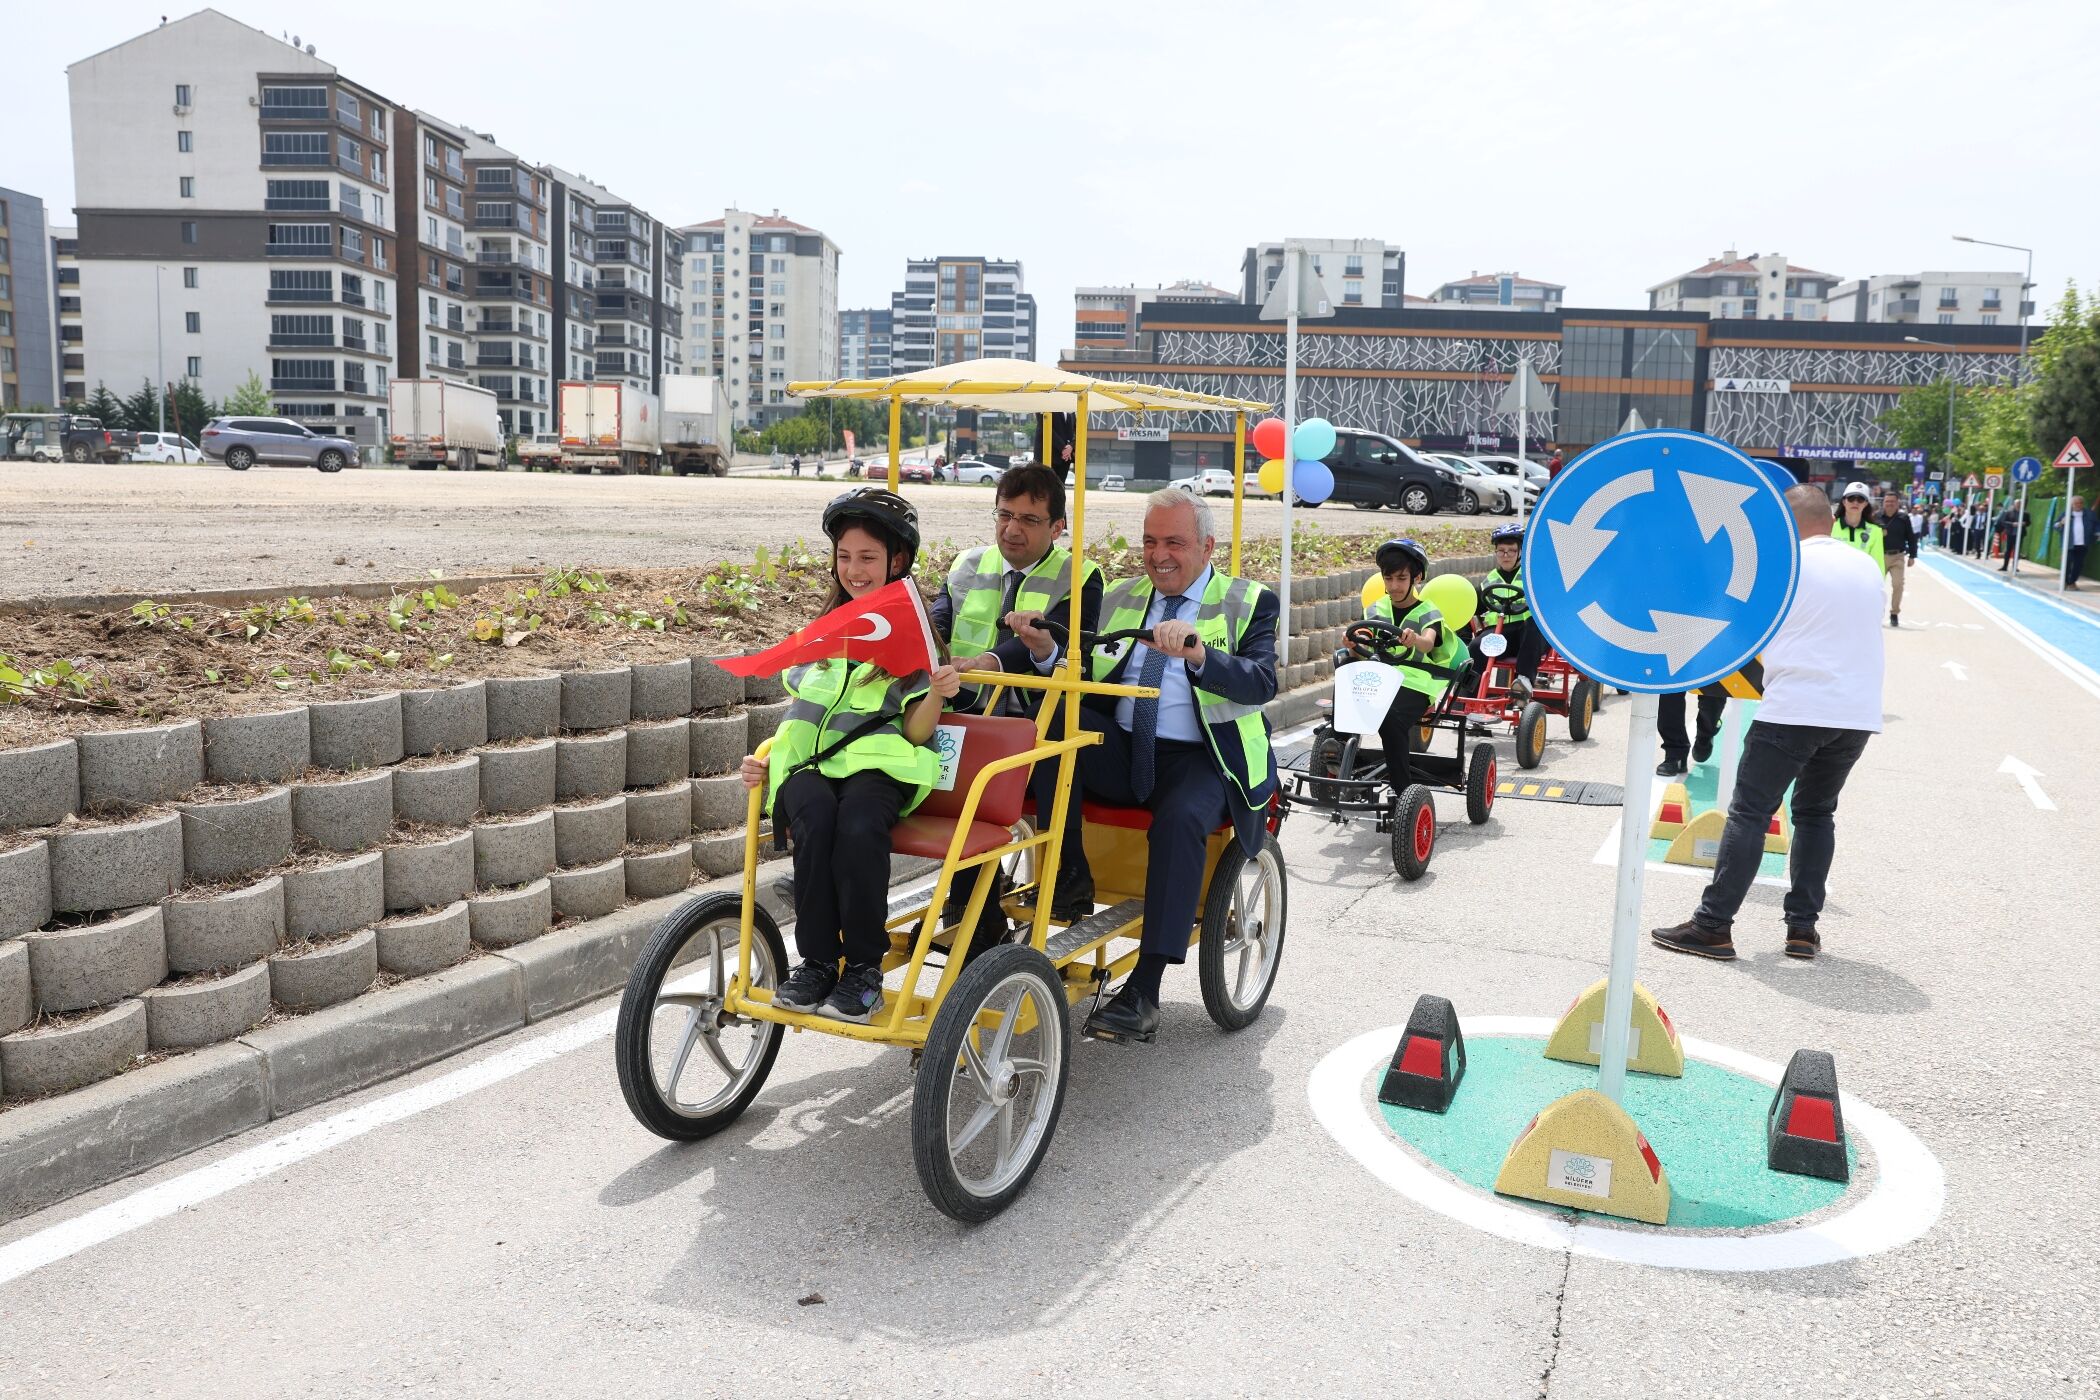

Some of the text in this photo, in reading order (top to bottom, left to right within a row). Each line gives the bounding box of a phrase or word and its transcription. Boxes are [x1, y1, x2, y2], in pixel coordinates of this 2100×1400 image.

[1743, 381, 1780, 391] ALFA
[1797, 448, 1907, 460] TRAFİK EĞİTİM SOKAĞI
